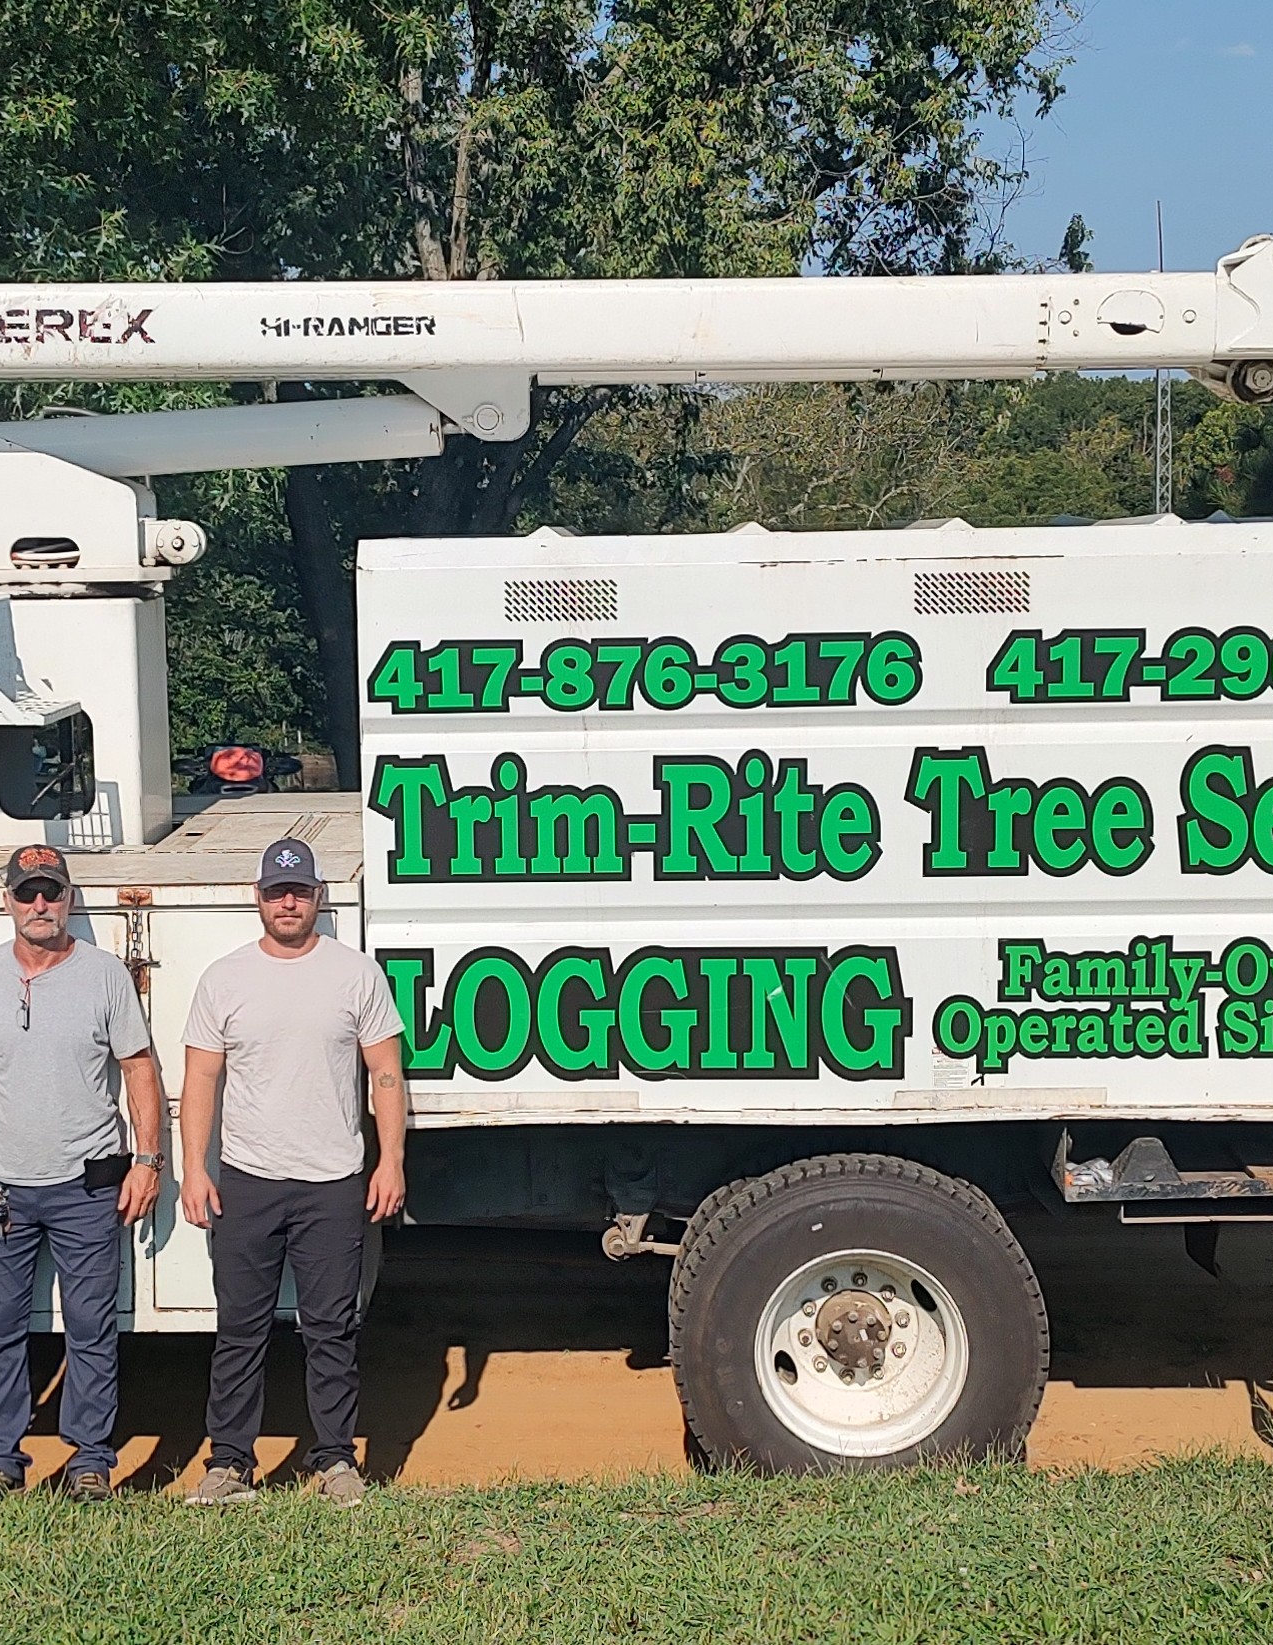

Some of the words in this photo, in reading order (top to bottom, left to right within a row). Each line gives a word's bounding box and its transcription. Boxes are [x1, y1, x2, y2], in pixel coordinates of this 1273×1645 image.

[259, 314, 437, 337] HI-RANGER
[370, 634, 920, 713] 417-876-3176
[373, 754, 877, 880] Trim-Rite
[910, 751, 1149, 873] Tree
[382, 952, 906, 1075] LOGGING
[935, 996, 1207, 1071] Operated
